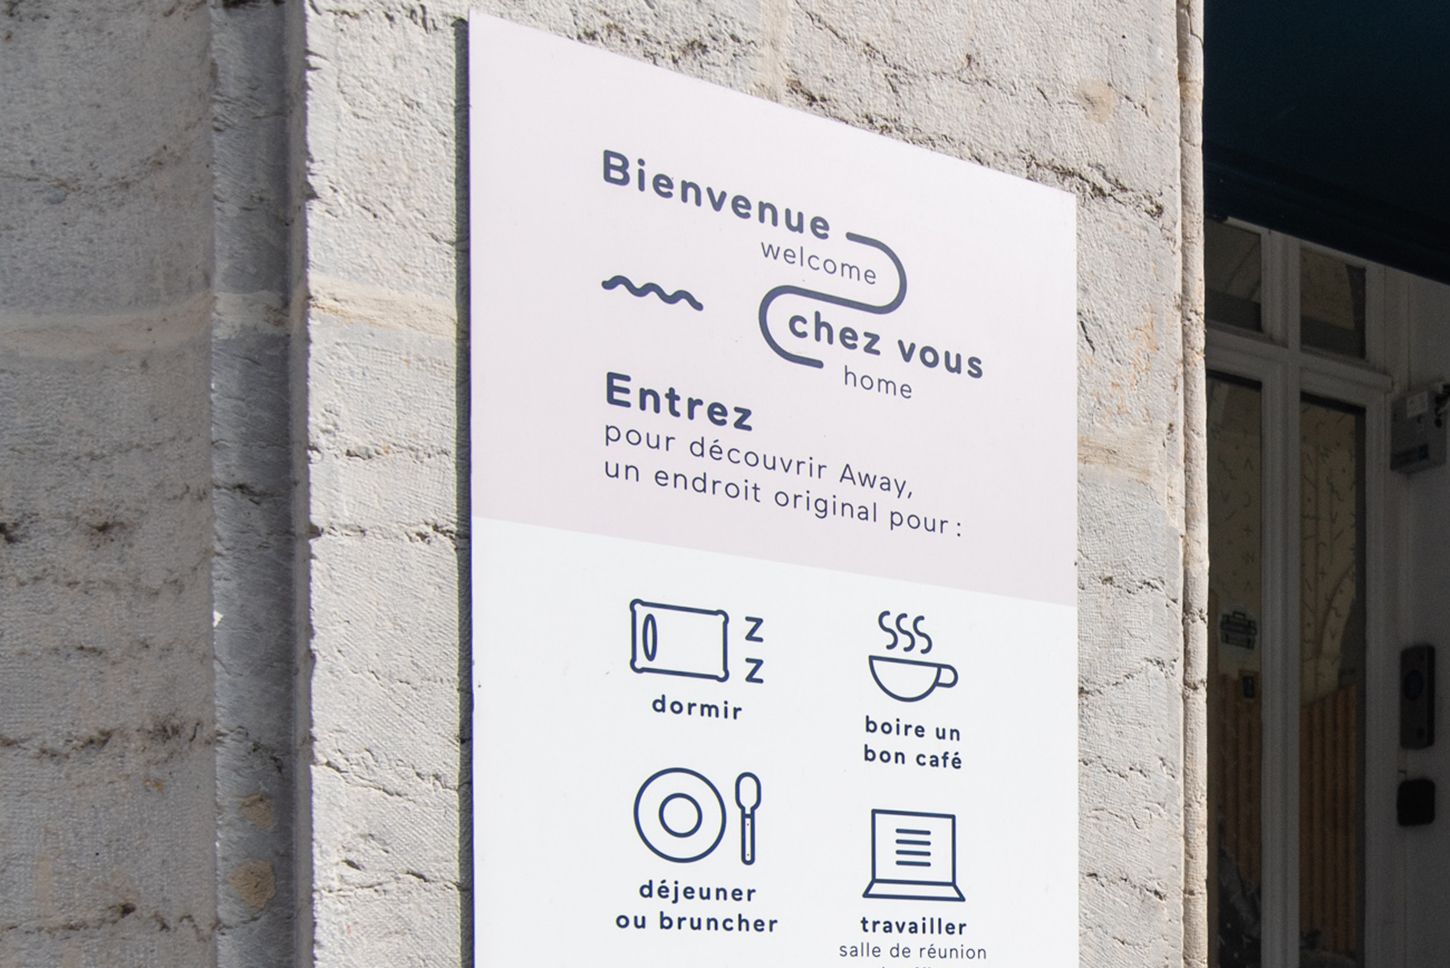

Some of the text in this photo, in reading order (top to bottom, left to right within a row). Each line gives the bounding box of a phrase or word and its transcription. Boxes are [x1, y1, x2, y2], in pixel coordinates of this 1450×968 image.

[603, 149, 830, 240] Bienvenue
[761, 242, 876, 285] welcome
[789, 311, 983, 379] chez vous
[845, 365, 912, 399] home
[606, 372, 752, 431] Entrez
[605, 425, 912, 499] pour découvrir Away,
[605, 461, 639, 482] un
[654, 470, 760, 503] endroit
[774, 490, 876, 522] original
[890, 511, 948, 534] pour
[652, 694, 742, 720] dormir
[865, 715, 960, 742] boire un
[864, 744, 962, 769] bon café
[639, 879, 756, 904] déjeuner
[616, 911, 778, 932] ou bruncher
[860, 916, 967, 935] travailler
[840, 942, 986, 959] salle de réunion
